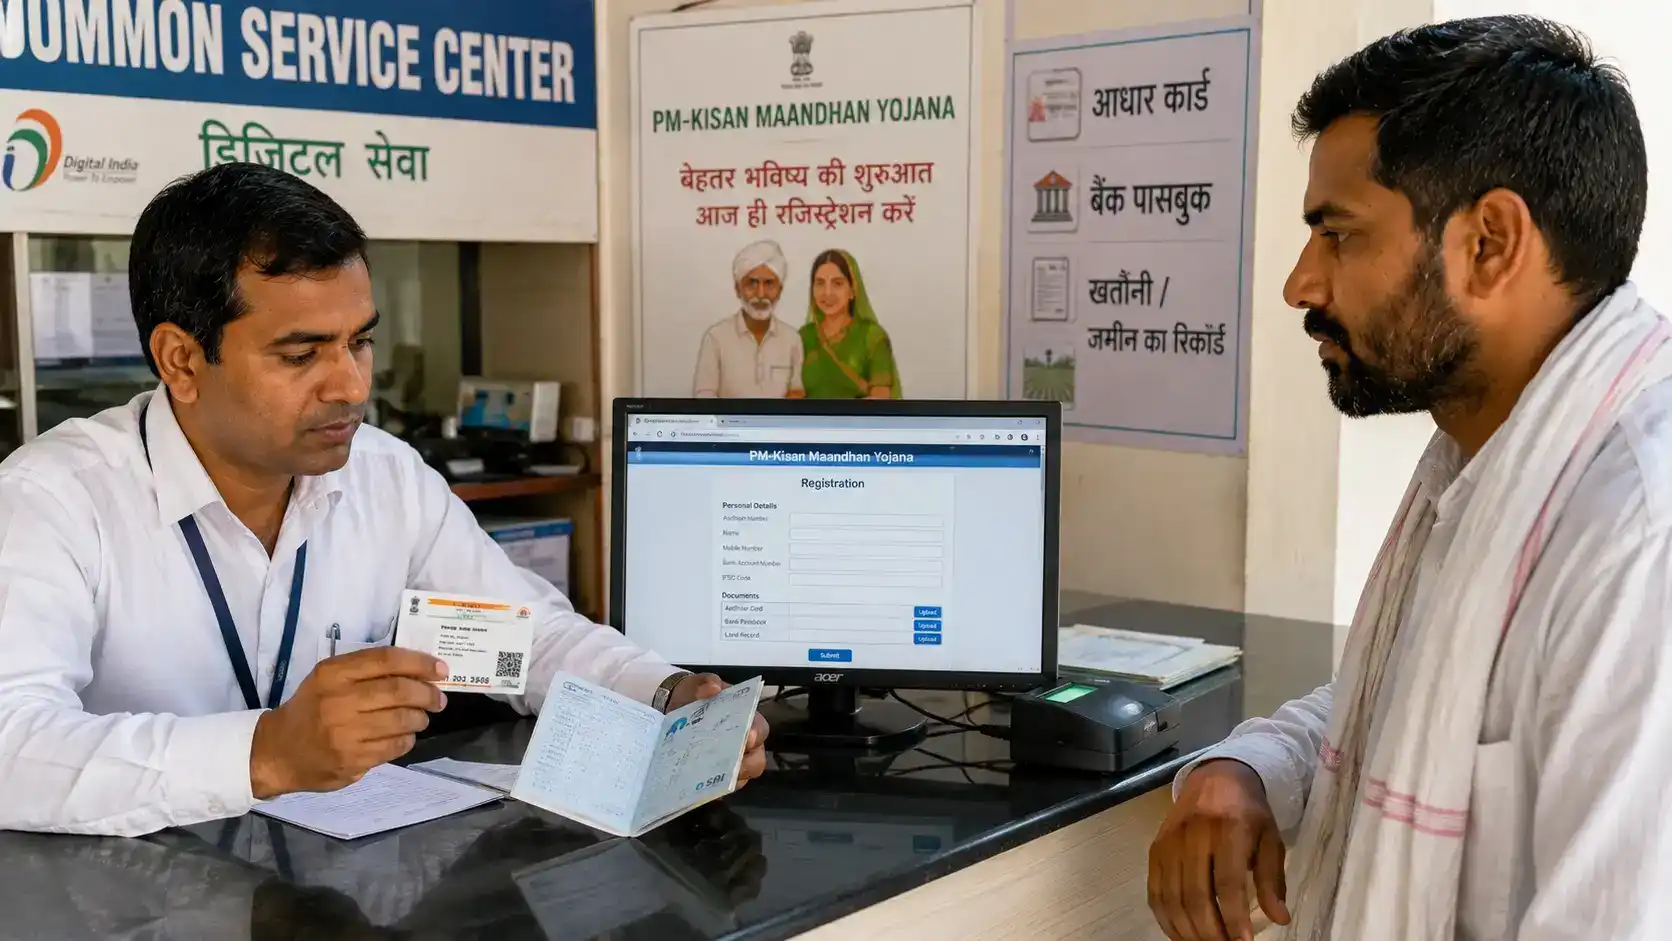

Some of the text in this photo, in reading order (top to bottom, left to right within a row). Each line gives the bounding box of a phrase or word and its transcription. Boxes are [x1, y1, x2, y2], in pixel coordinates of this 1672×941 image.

[240, 6, 422, 91] SERVICE
[433, 27, 576, 104] CENTER
[1092, 67, 1211, 118] आधार कार्ड
[652, 95, 956, 133] PM-KISAN MAANDHAN YOJANA
[63, 155, 140, 172] Digital India
[364, 130, 430, 181] सेवा
[679, 157, 934, 193] बेहतर भविष्य की शुरुआत
[696, 194, 917, 230] आज ही रजिस्ट्रेशन करें
[1090, 174, 1213, 226] बैंक पासबुक
[1159, 276, 1170, 308] /
[1087, 320, 1139, 351] जमीन
[1143, 329, 1168, 353] का
[749, 450, 915, 465] PM-Kisan Maandhan Yojana
[801, 477, 865, 491] Registration
[722, 501, 778, 510] Personal Details
[721, 591, 760, 600] Documents
[814, 673, 844, 683] acer
